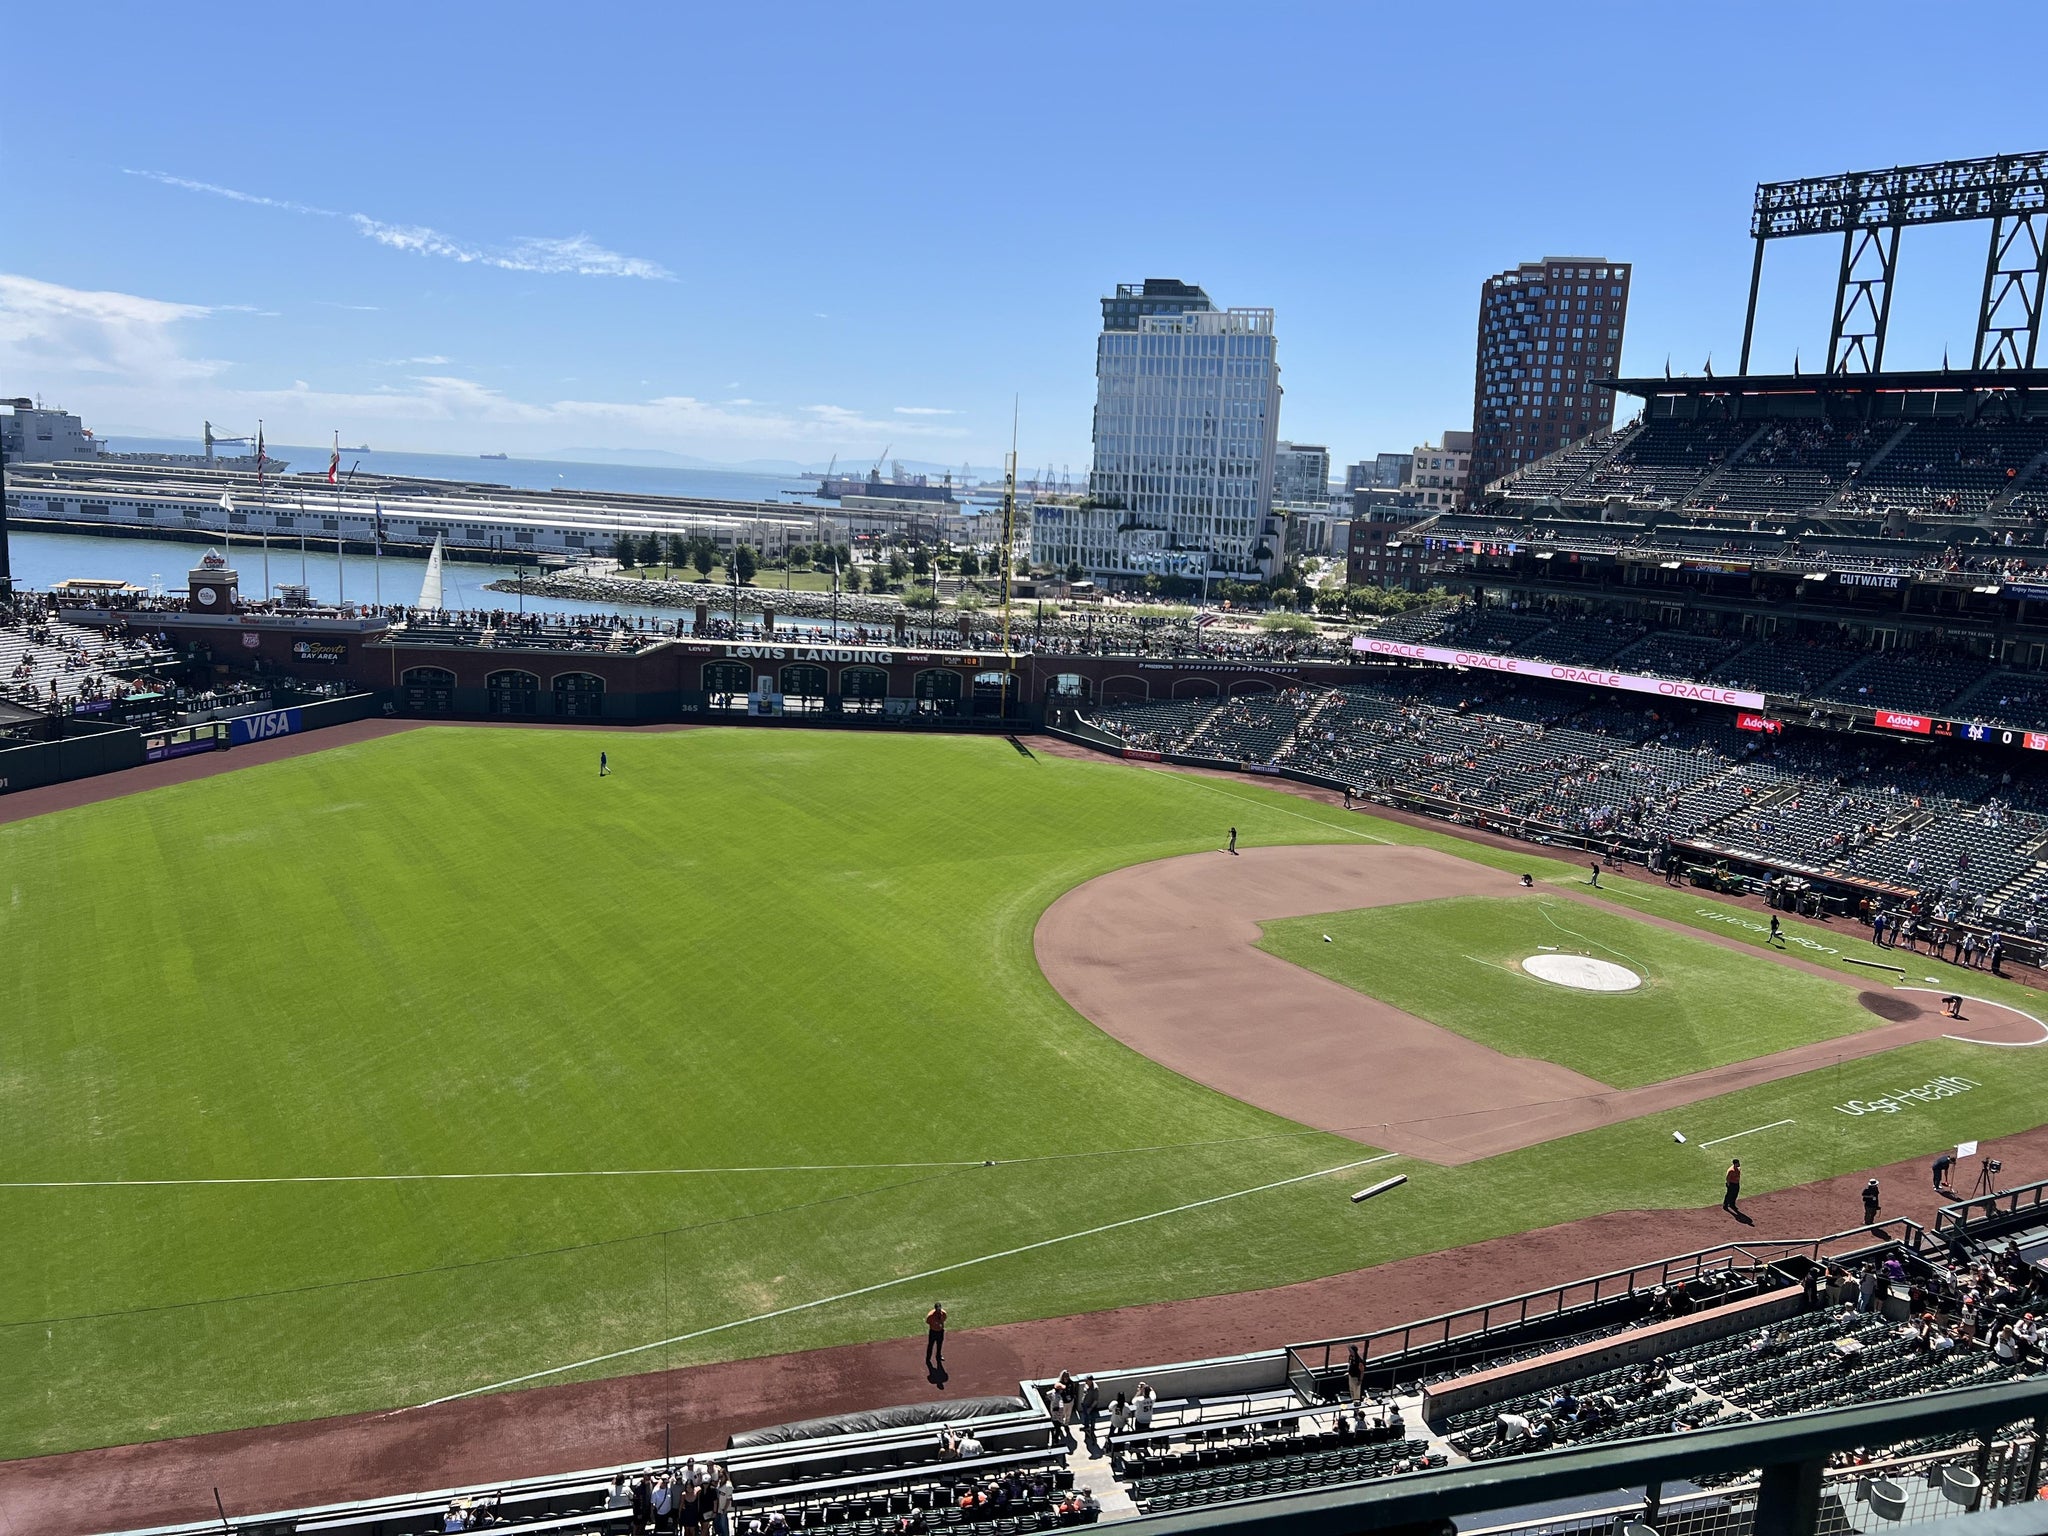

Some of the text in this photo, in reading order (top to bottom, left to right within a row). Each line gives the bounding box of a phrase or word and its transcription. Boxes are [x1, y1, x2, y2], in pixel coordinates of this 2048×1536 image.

[1839, 574, 1898, 588] CUTWATER
[1070, 614, 1188, 627] BANK OF AMERICA
[309, 642, 346, 654] Sports
[1370, 641, 1425, 658] ORACLE
[793, 649, 893, 664] LANDING
[1455, 653, 1517, 671] ORACLE
[1551, 667, 1620, 687] ORACLE
[1658, 682, 1736, 704] ORACLE
[187, 700, 220, 711] WELCOME
[259, 690, 271, 699] 415
[682, 704, 698, 712] 365
[242, 712, 289, 740] VISA
[1743, 717, 1775, 731] Adobe
[1886, 715, 1920, 727] Adobe
[2002, 731, 2012, 744] 0
[1127, 751, 1156, 759] ORACLE
[1881, 1076, 1982, 1106] Health
